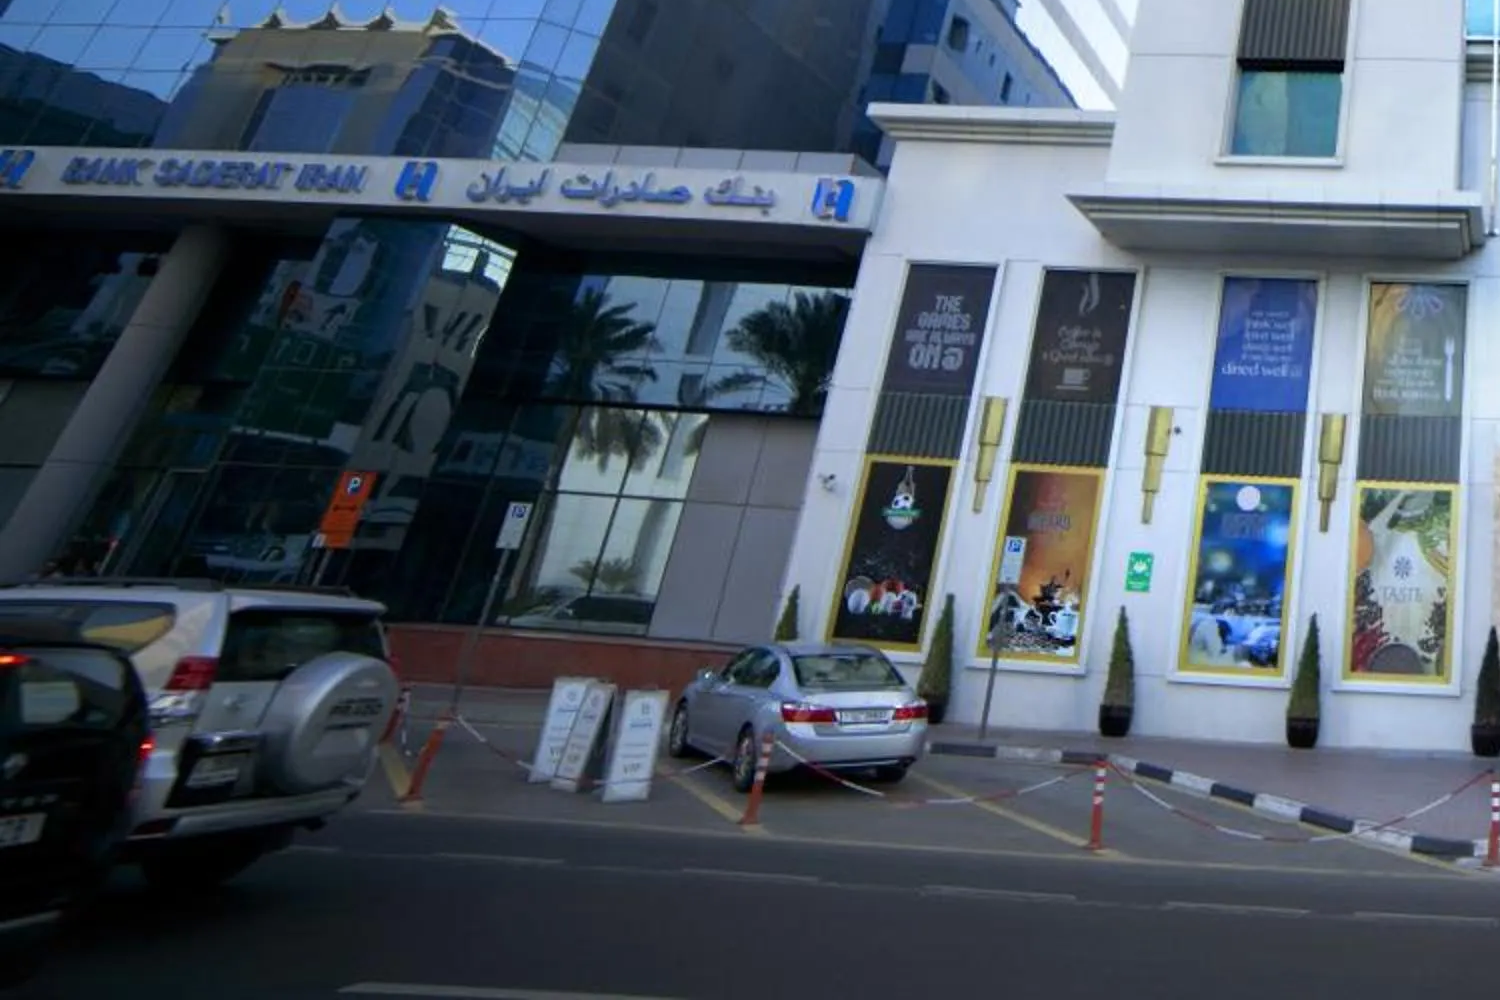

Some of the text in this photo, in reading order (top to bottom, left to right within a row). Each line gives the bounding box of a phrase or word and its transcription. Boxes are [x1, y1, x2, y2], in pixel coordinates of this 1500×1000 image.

[62, 156, 369, 193] BANK SADERAT IRAN
[936, 295, 964, 312] THE
[918, 312, 971, 330] GAMES
[1380, 586, 1423, 603] TASTE
